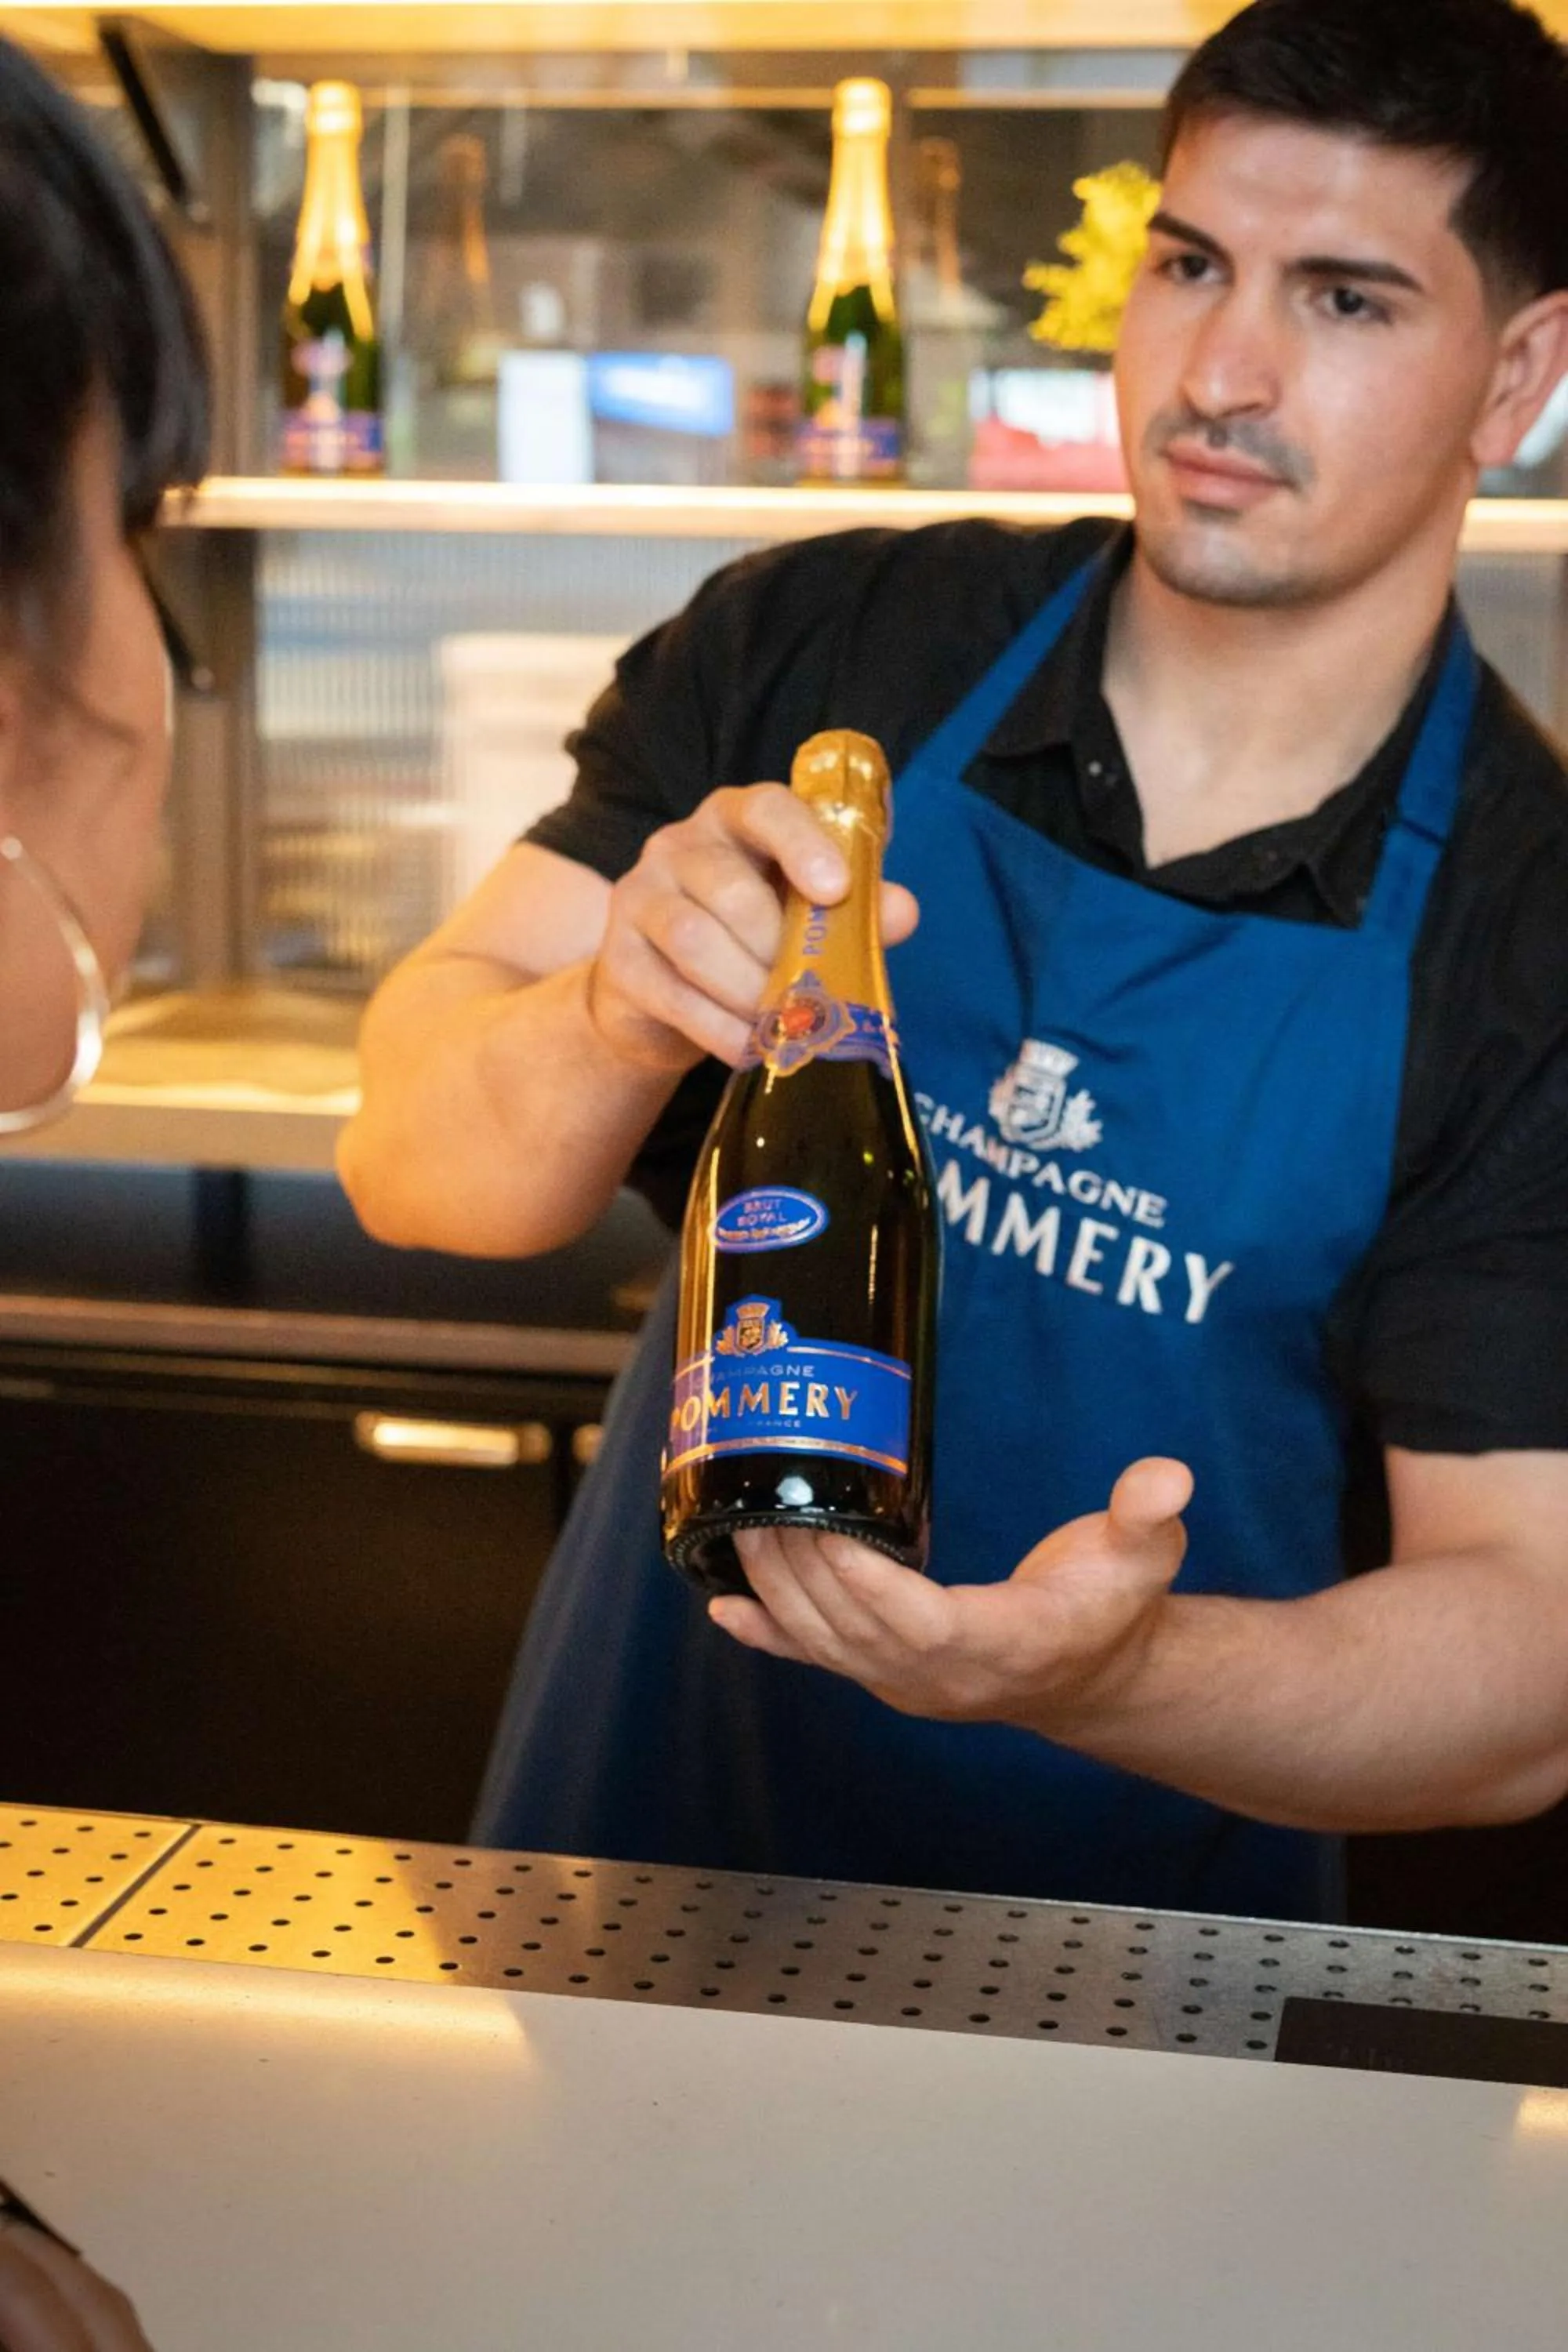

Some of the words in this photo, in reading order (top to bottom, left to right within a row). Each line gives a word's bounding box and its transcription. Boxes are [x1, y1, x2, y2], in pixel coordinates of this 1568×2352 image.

[914, 1091, 1168, 1229] CHAMPAGNE
[743, 1198, 783, 1214] BRUT
[737, 1212, 787, 1227] ROYAL
